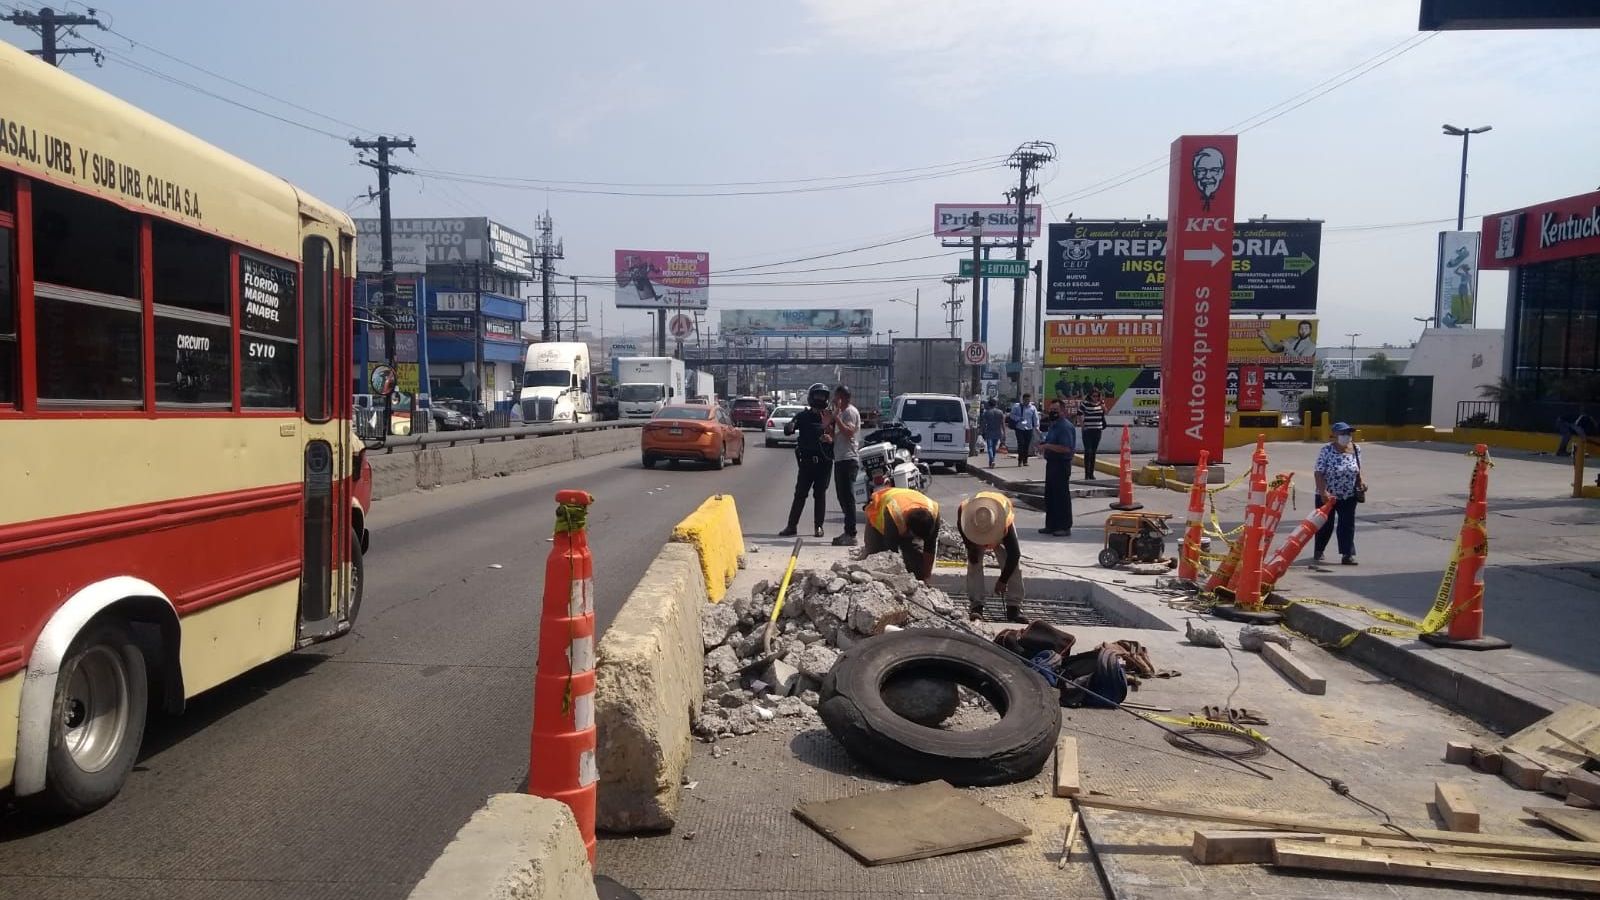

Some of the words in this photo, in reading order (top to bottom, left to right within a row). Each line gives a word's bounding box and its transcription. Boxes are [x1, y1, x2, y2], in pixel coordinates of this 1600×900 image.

[45, 135, 76, 176] URB.
[79, 148, 88, 179] Y
[93, 153, 115, 189] SUB
[119, 163, 144, 200] URB.
[147, 175, 181, 211] CALFIA
[184, 189, 202, 219] S.A.
[1075, 226, 1088, 238] El
[1185, 218, 1227, 232] KFC
[988, 264, 1026, 274] ENTRADA
[244, 273, 279, 294] FLORIDO
[244, 288, 279, 308] MARIANO
[246, 302, 279, 322] ANABEL
[1058, 322, 1108, 335] NOW
[177, 334, 210, 351] CIRCUITO
[970, 346, 981, 357] 60
[1185, 286, 1212, 440] Autoexpress
